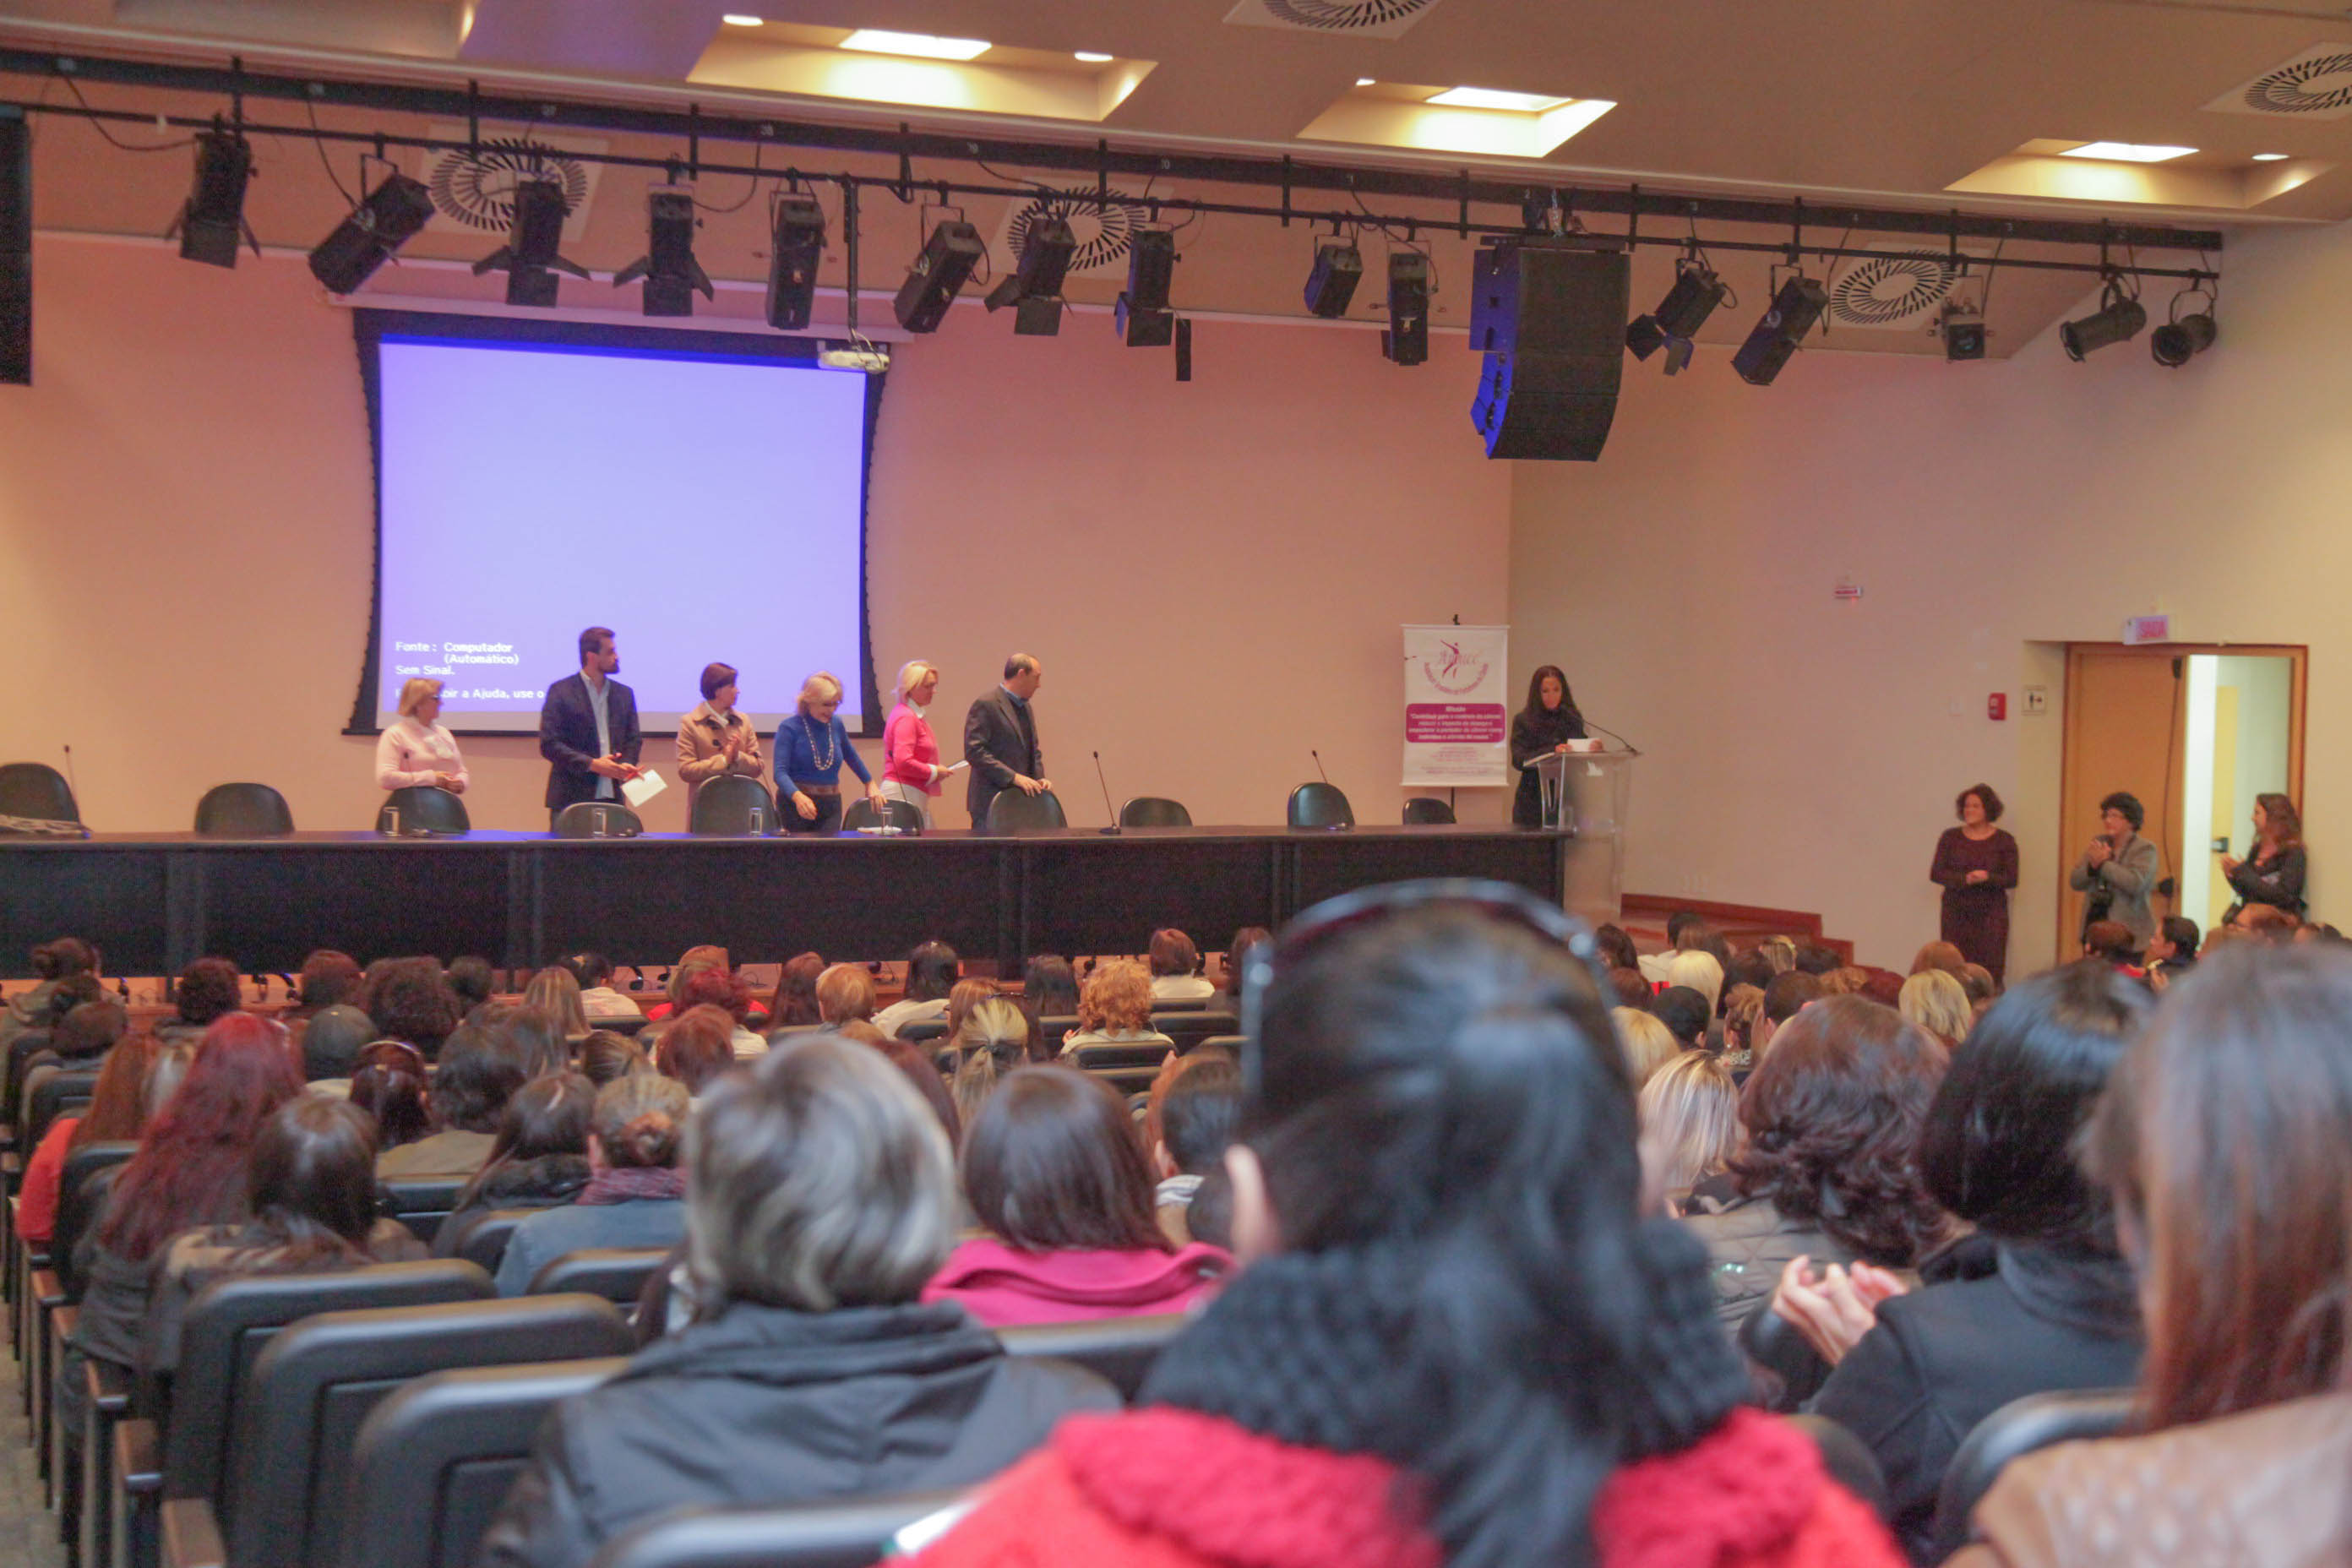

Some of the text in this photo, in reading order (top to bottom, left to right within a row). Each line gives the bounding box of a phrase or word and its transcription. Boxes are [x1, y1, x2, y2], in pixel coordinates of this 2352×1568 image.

[395, 641, 430, 653] Fonte
[444, 642, 514, 655] Computador
[444, 653, 519, 665] (Automático)
[395, 665, 455, 676] Sem Sinal.
[472, 689, 510, 700] Ajuda,
[513, 690, 535, 699] use
